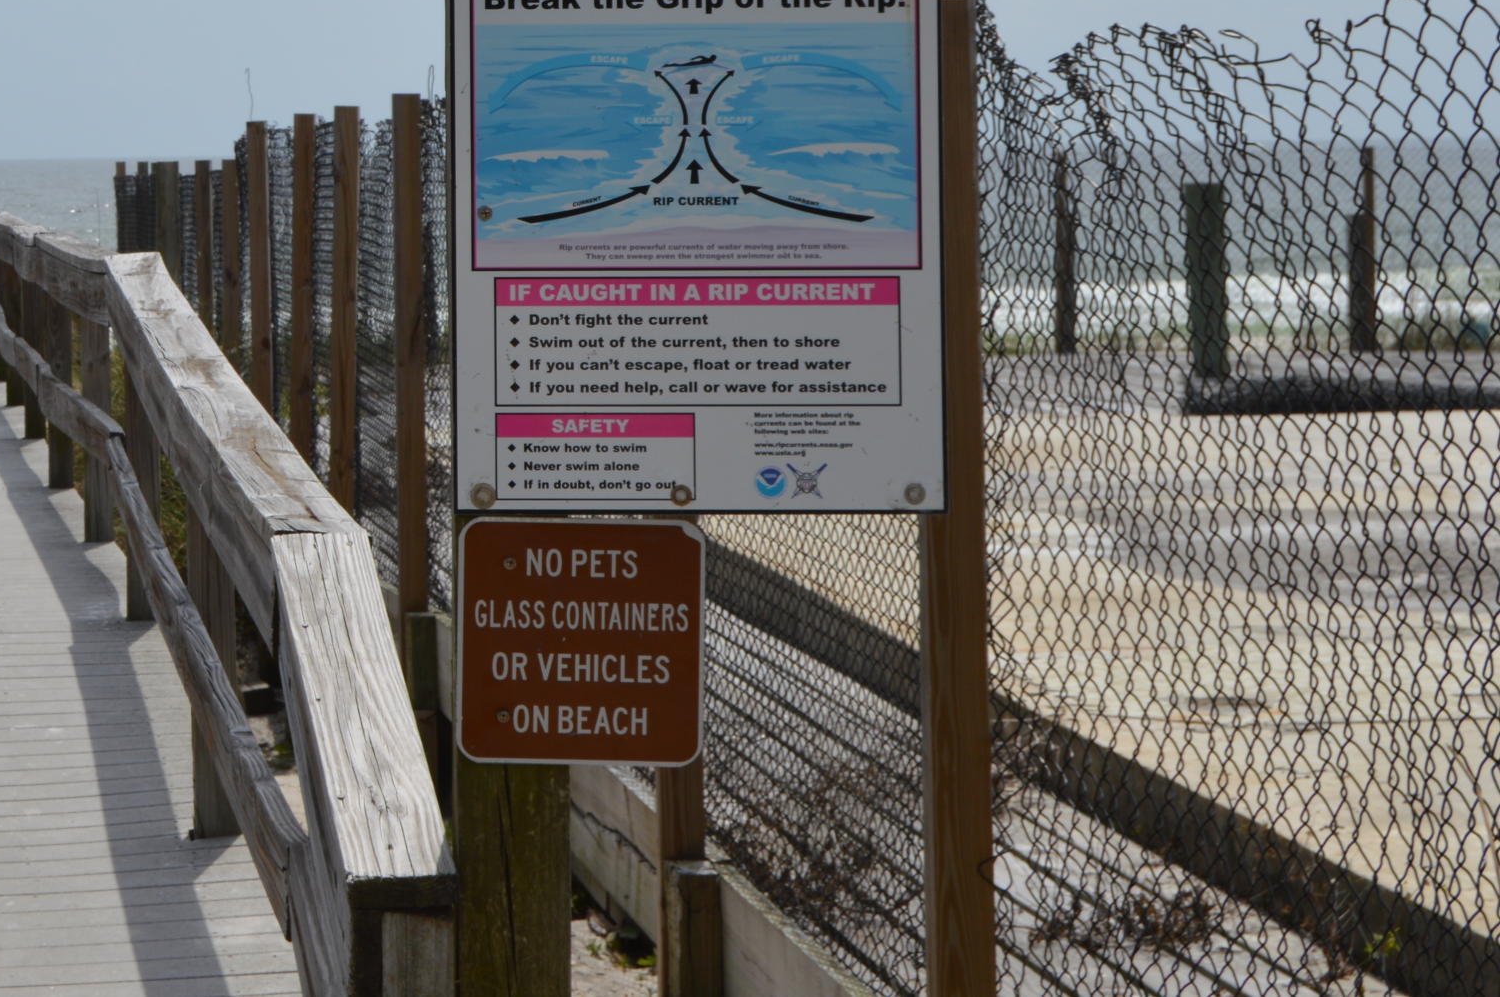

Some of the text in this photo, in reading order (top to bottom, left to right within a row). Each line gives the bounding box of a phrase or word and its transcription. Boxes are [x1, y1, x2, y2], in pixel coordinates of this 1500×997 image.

[590, 55, 628, 65] ESCAPE
[762, 54, 800, 63] ESCAPE
[633, 116, 671, 124] ESCAPE
[717, 116, 754, 124] ESCAPE
[572, 196, 602, 207] CURRENT
[653, 196, 738, 206] RIP CURRENT
[509, 283, 875, 301] IF CAUGHT IN A RIP CURRENT
[574, 313, 612, 328] fight
[617, 313, 643, 325] the
[648, 314, 708, 325] current
[529, 335, 840, 350] Swim out of the current, then to shore
[552, 418, 628, 433] SAFETY
[523, 479, 533, 489] If
[537, 479, 549, 489] in
[553, 479, 594, 490] doubt,
[635, 481, 651, 491] go
[526, 548, 637, 579] NO PETS
[474, 599, 688, 631] GLASS CONTAINERS
[491, 651, 669, 683] OR VEHICLES
[512, 704, 647, 735] ON BEACH
